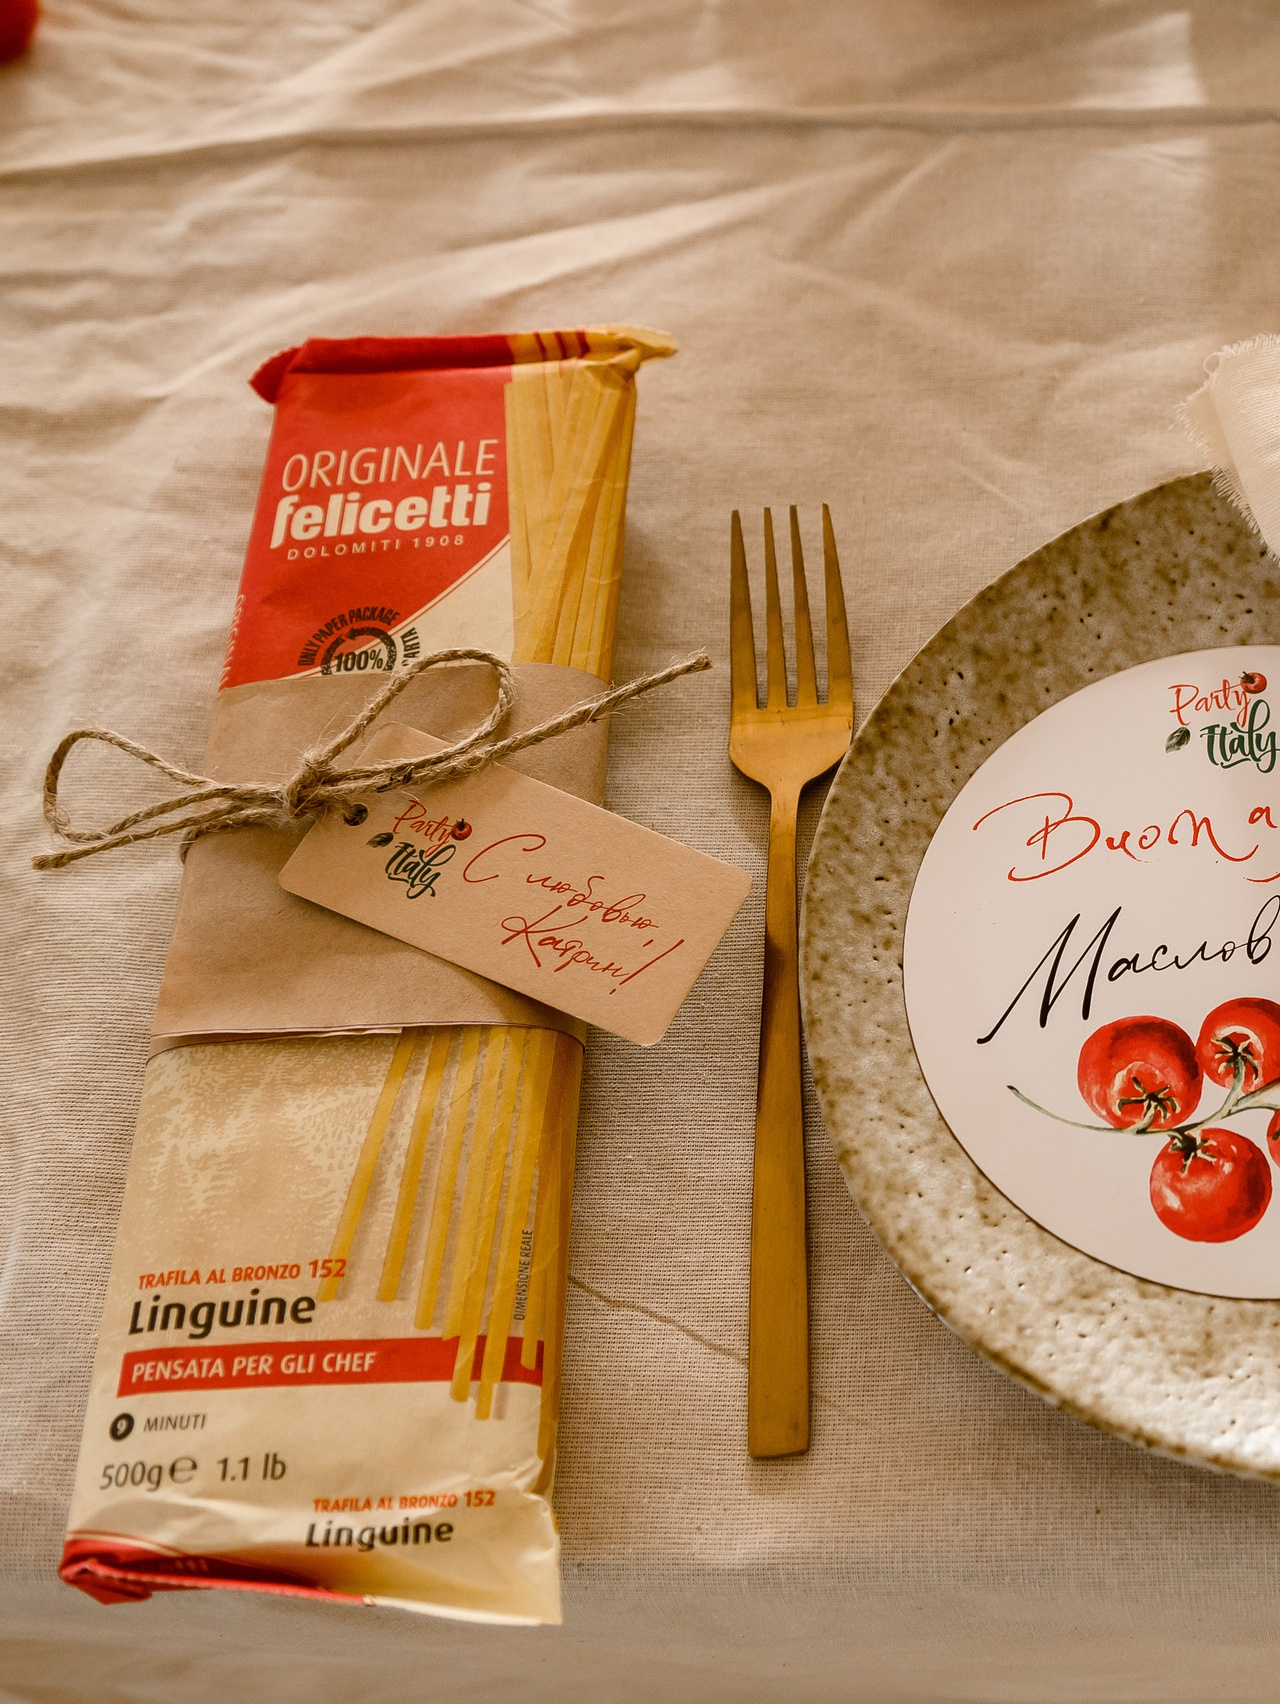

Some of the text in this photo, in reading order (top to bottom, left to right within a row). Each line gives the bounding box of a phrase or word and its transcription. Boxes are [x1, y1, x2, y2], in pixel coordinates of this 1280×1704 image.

[281, 438, 499, 493] ORIGINALE
[270, 481, 492, 550] felicetti
[286, 533, 465, 561] DOLOMITI 1908
[297, 605, 400, 667] ONLY PAPER PACKAGE
[334, 648, 384, 673] 100%
[1167, 678, 1252, 729] Party
[392, 799, 456, 859] Party
[973, 792, 1260, 882] Buon
[384, 842, 457, 900] Italy
[138, 1258, 347, 1290] TRAFILA AL BRONZO 152
[513, 1229, 534, 1321] DIMENSIONE REALE
[128, 1288, 317, 1340] Linguine
[131, 1351, 377, 1384] PENSATA PER GLI CHEF
[143, 1413, 208, 1433] MINUTI
[99, 1461, 163, 1493] 500g
[217, 1456, 250, 1482] 1.1
[261, 1452, 286, 1481] lb
[312, 1488, 497, 1514] TRAFILA AL BRONZO 152
[304, 1516, 455, 1553] Linguine
